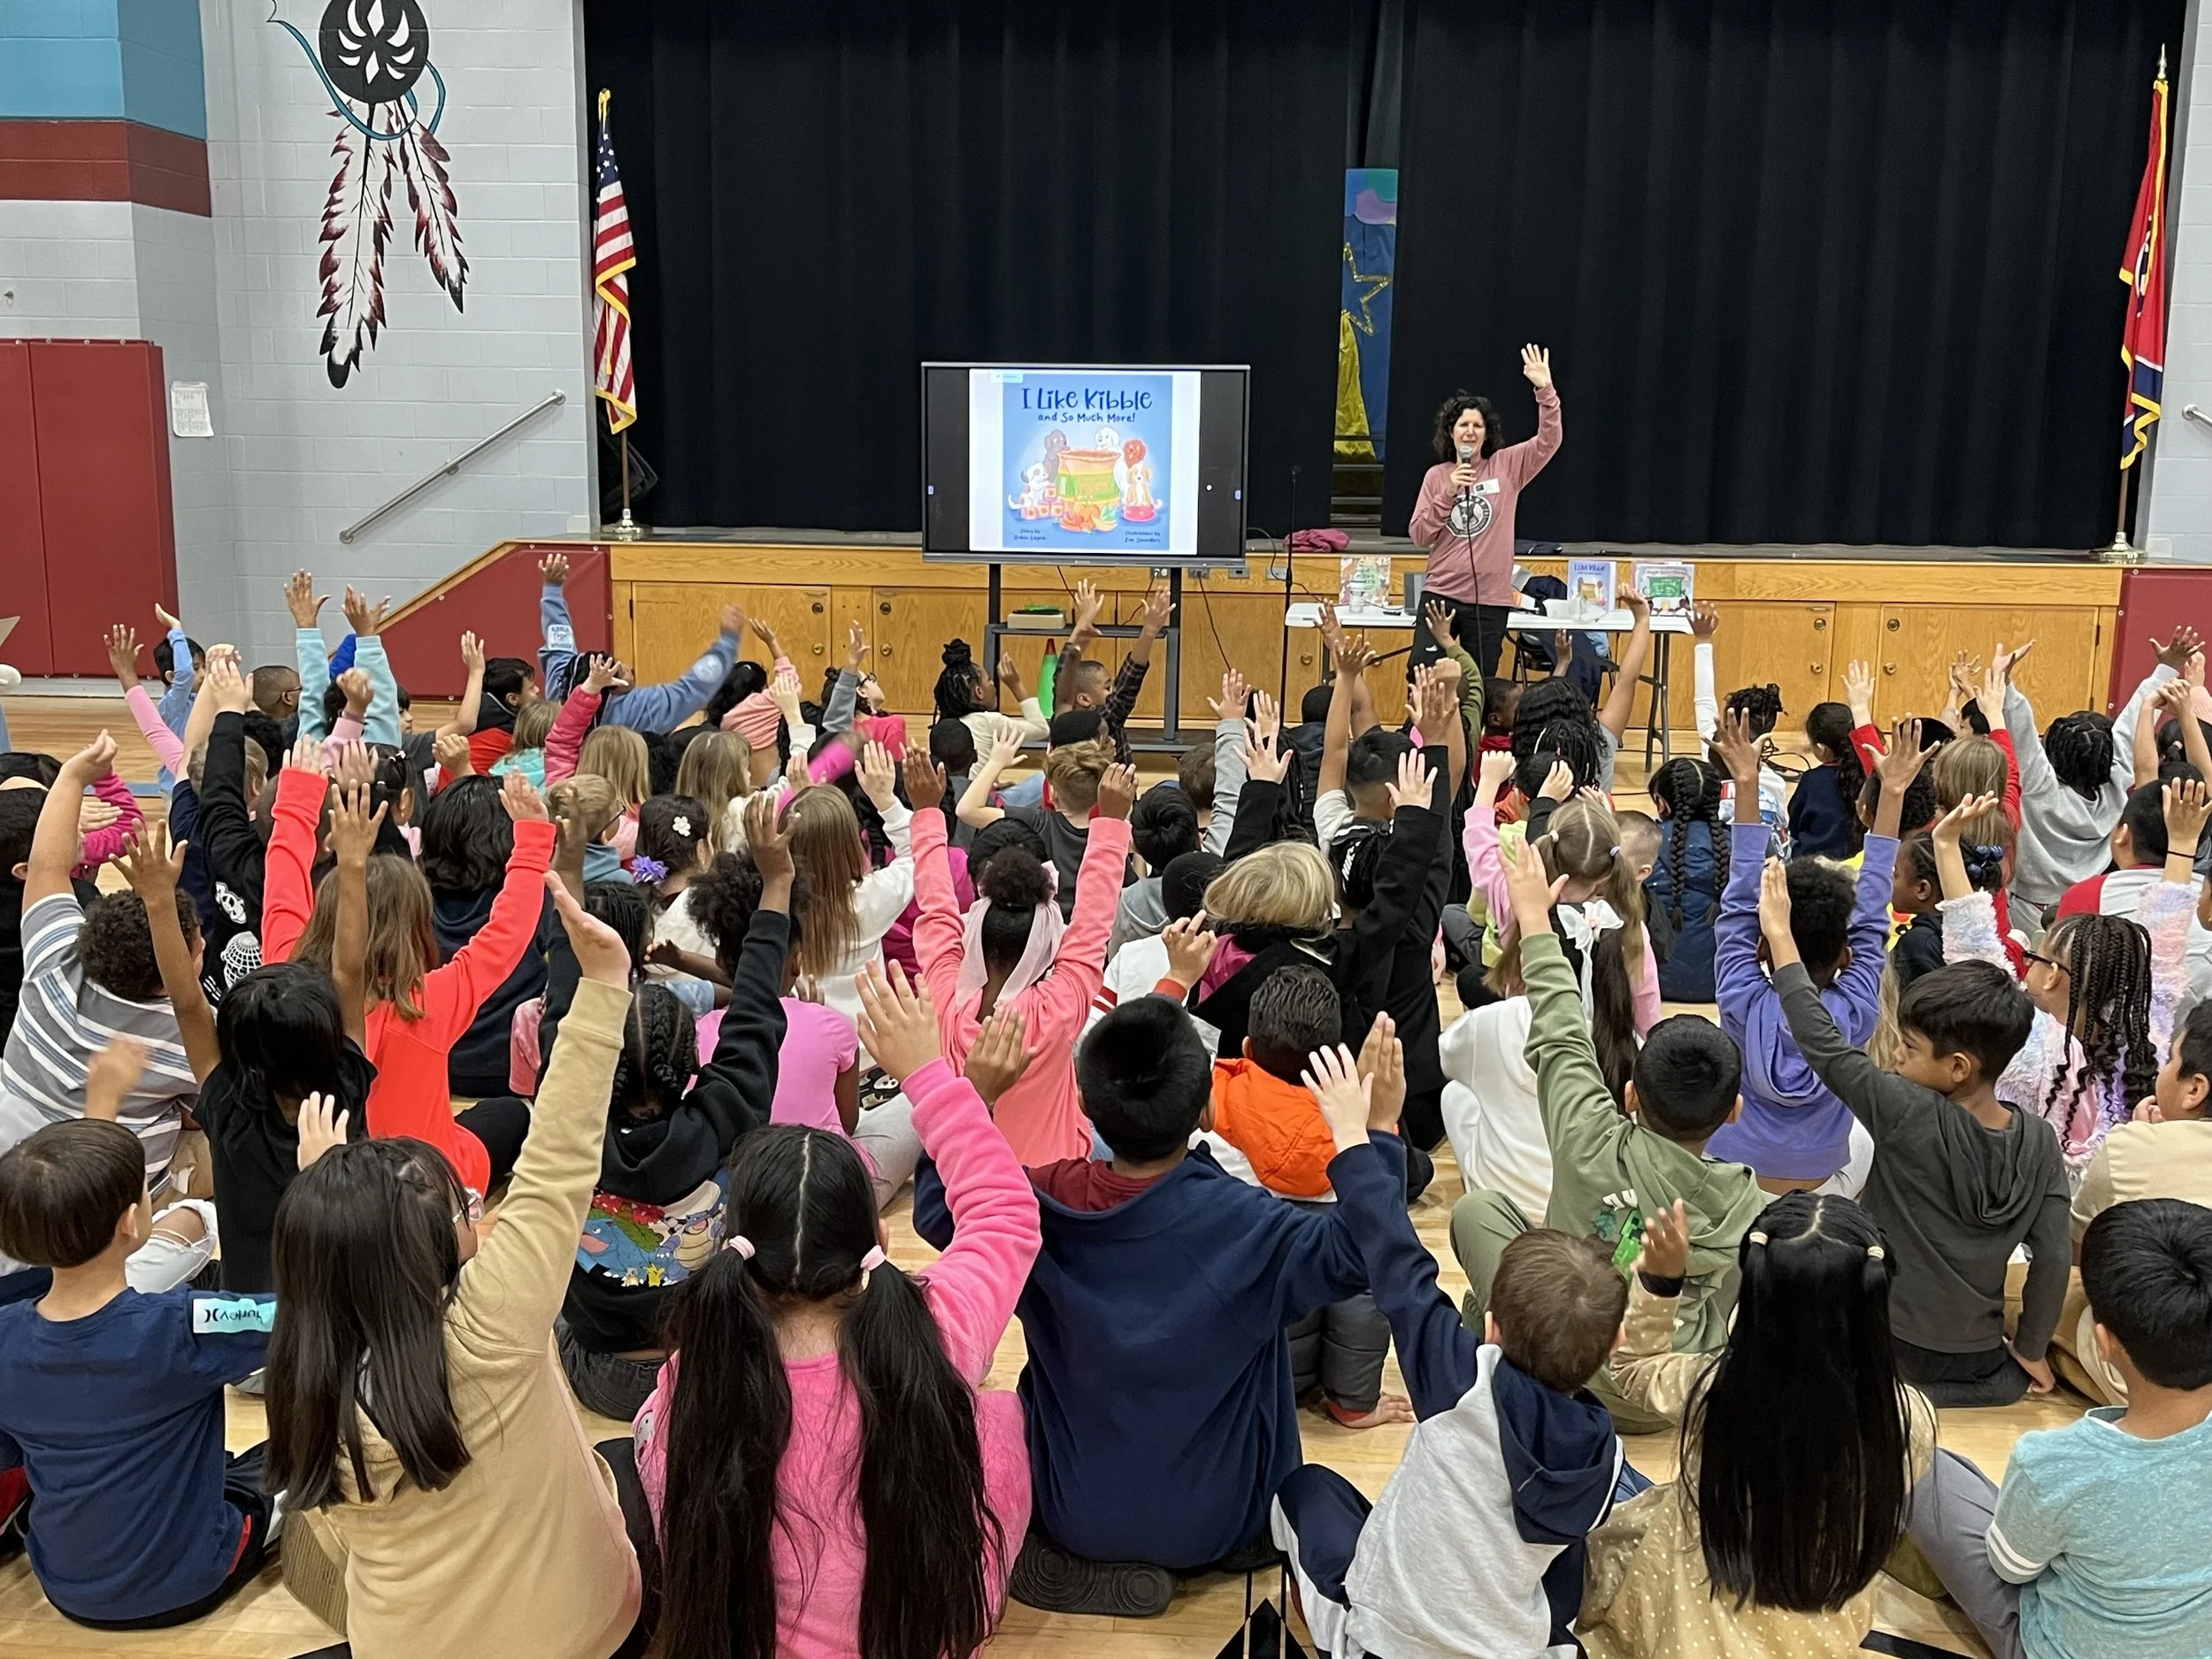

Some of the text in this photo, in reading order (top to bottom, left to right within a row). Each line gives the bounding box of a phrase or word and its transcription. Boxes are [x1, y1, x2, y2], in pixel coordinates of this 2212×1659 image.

[1021, 387, 1153, 411] I Like Kibble
[1037, 411, 1136, 423] and So Much More!
